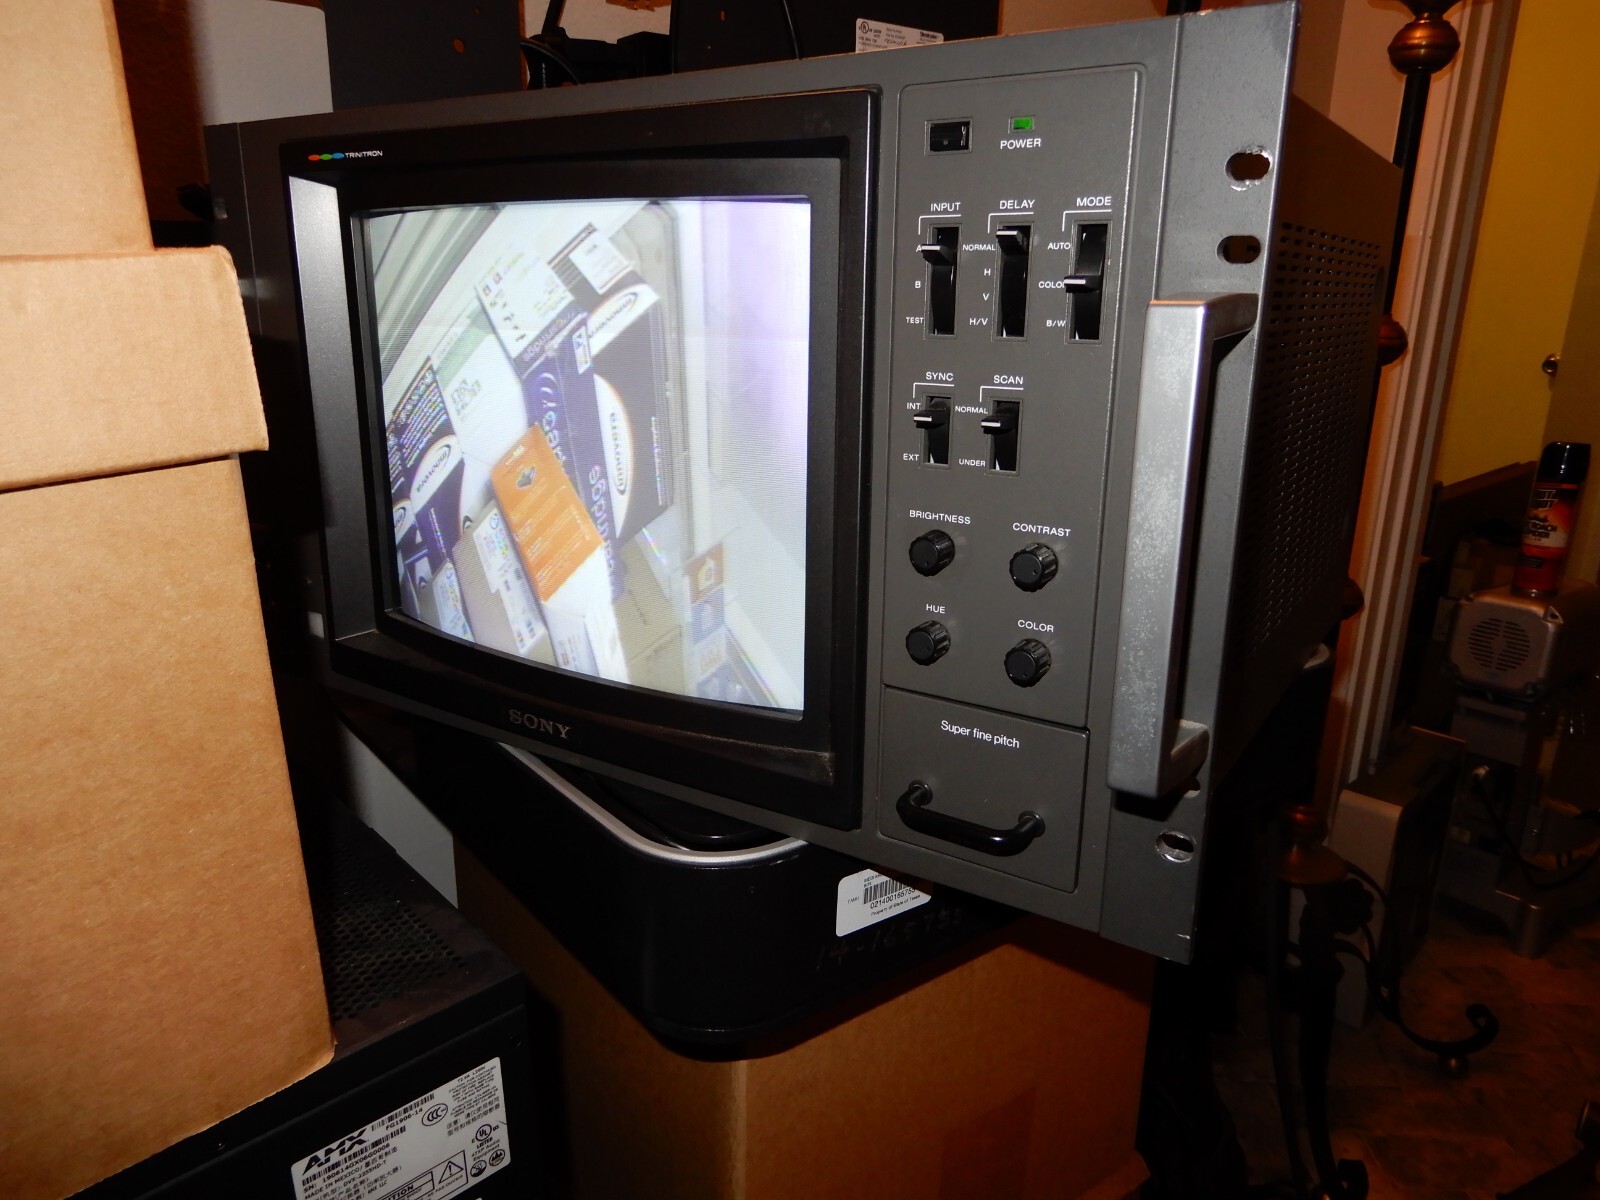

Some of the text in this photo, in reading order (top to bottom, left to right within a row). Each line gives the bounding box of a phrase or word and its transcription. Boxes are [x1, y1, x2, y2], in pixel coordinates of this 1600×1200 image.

[1000, 138, 1042, 150] POWER
[344, 150, 383, 158] TRINITRON
[930, 202, 960, 212] INPUT
[1000, 200, 1035, 210] DELAY
[1076, 196, 1112, 207] MODE
[926, 372, 954, 381] SYNC
[993, 375, 1024, 385] SCAN
[955, 406, 988, 414] NORMAL
[959, 459, 985, 467] UNDER
[909, 509, 971, 525] BRIGHTNESS
[1012, 522, 1071, 537] CONTRAST
[926, 604, 946, 614] HUE
[1018, 619, 1054, 633] COLOR
[508, 709, 571, 738] SONY
[941, 720, 1020, 749] Super fine pitch
[385, 1106, 422, 1130] FG1906-14
[301, 1127, 368, 1176] AMX
[303, 1181, 316, 1193] SN:
[305, 1186, 323, 1200] MADE
